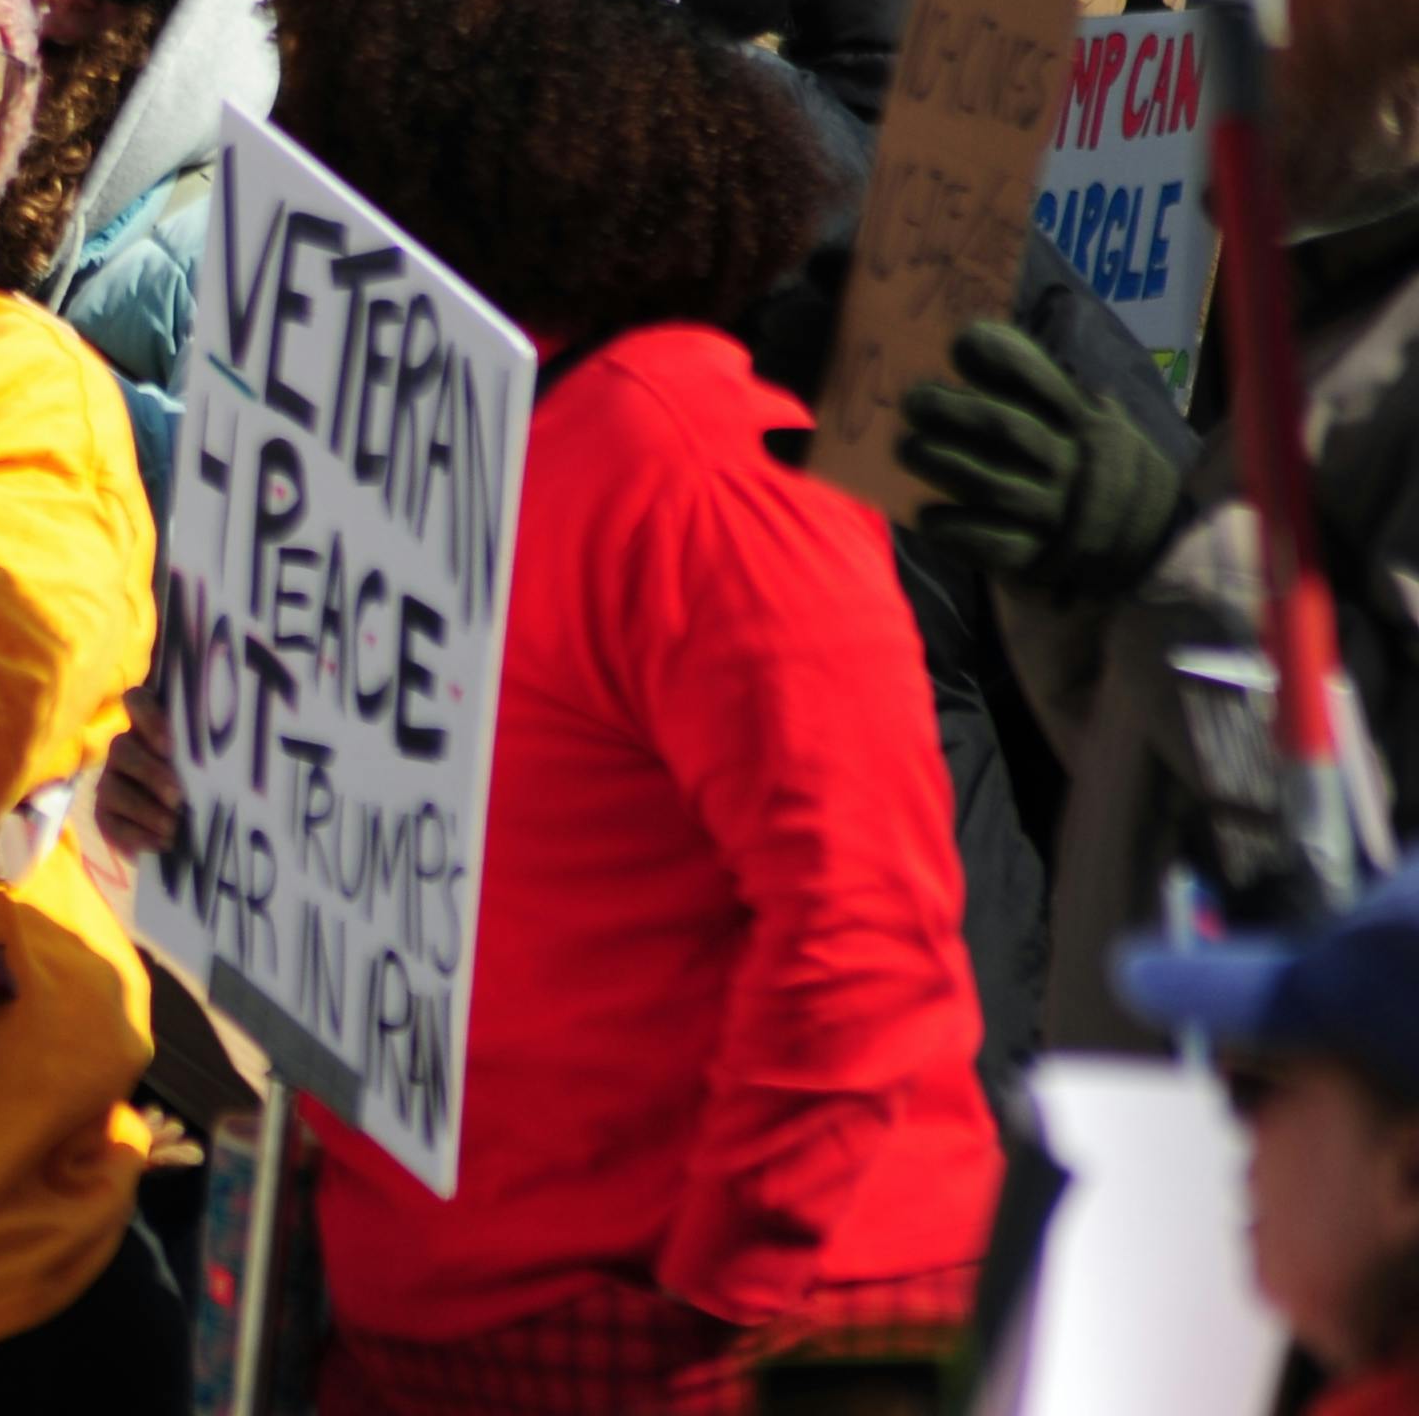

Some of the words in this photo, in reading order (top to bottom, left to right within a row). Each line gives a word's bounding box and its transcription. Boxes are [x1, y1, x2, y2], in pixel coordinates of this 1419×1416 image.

[1122, 32, 1205, 141] CAN
[222, 144, 512, 628] VETERAN
[157, 566, 300, 798] NOT
[249, 437, 447, 763] PEACE
[159, 790, 278, 975] WAR
[300, 902, 347, 1046] IN
[370, 948, 453, 1152] IRAN
